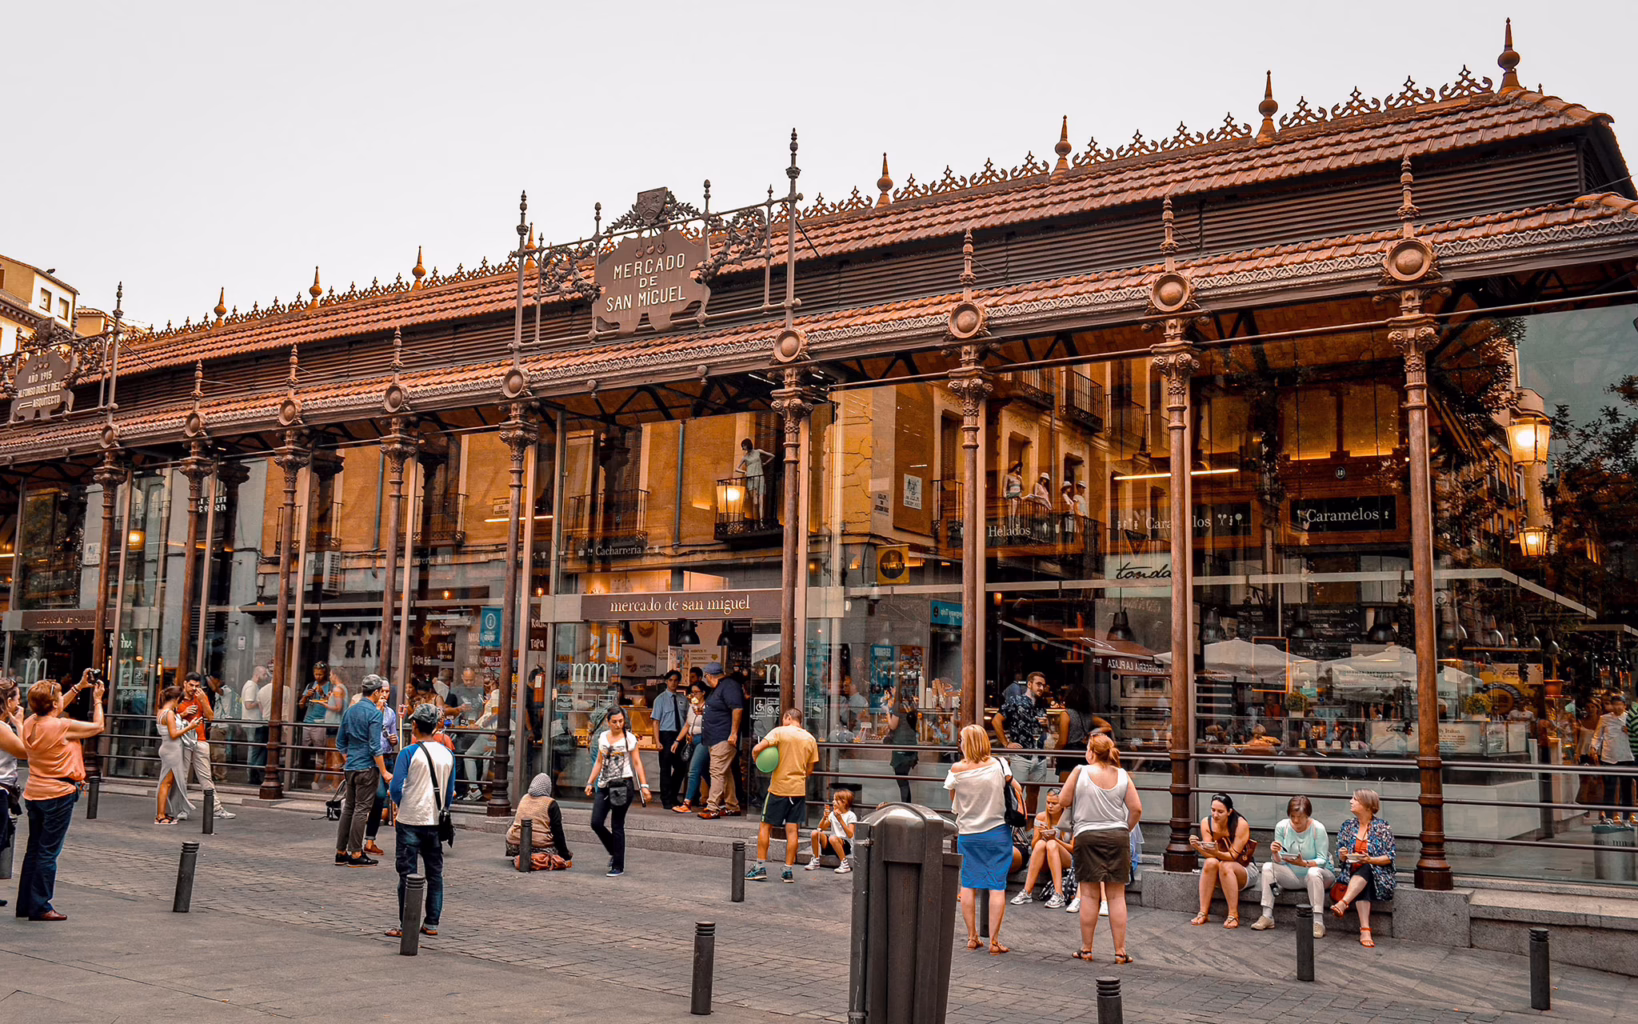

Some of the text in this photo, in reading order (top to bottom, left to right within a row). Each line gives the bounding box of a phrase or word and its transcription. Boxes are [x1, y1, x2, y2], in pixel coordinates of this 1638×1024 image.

[613, 253, 686, 280] MERCADO
[639, 275, 658, 289] DE
[606, 285, 687, 313] SAN MIGUEL
[28, 370, 53, 384] AÑO 1915
[1145, 515, 1211, 530] Caralos
[1305, 507, 1380, 523] Caramelos
[988, 524, 1031, 537] Helados
[610, 594, 751, 615] mercado de san miguel
